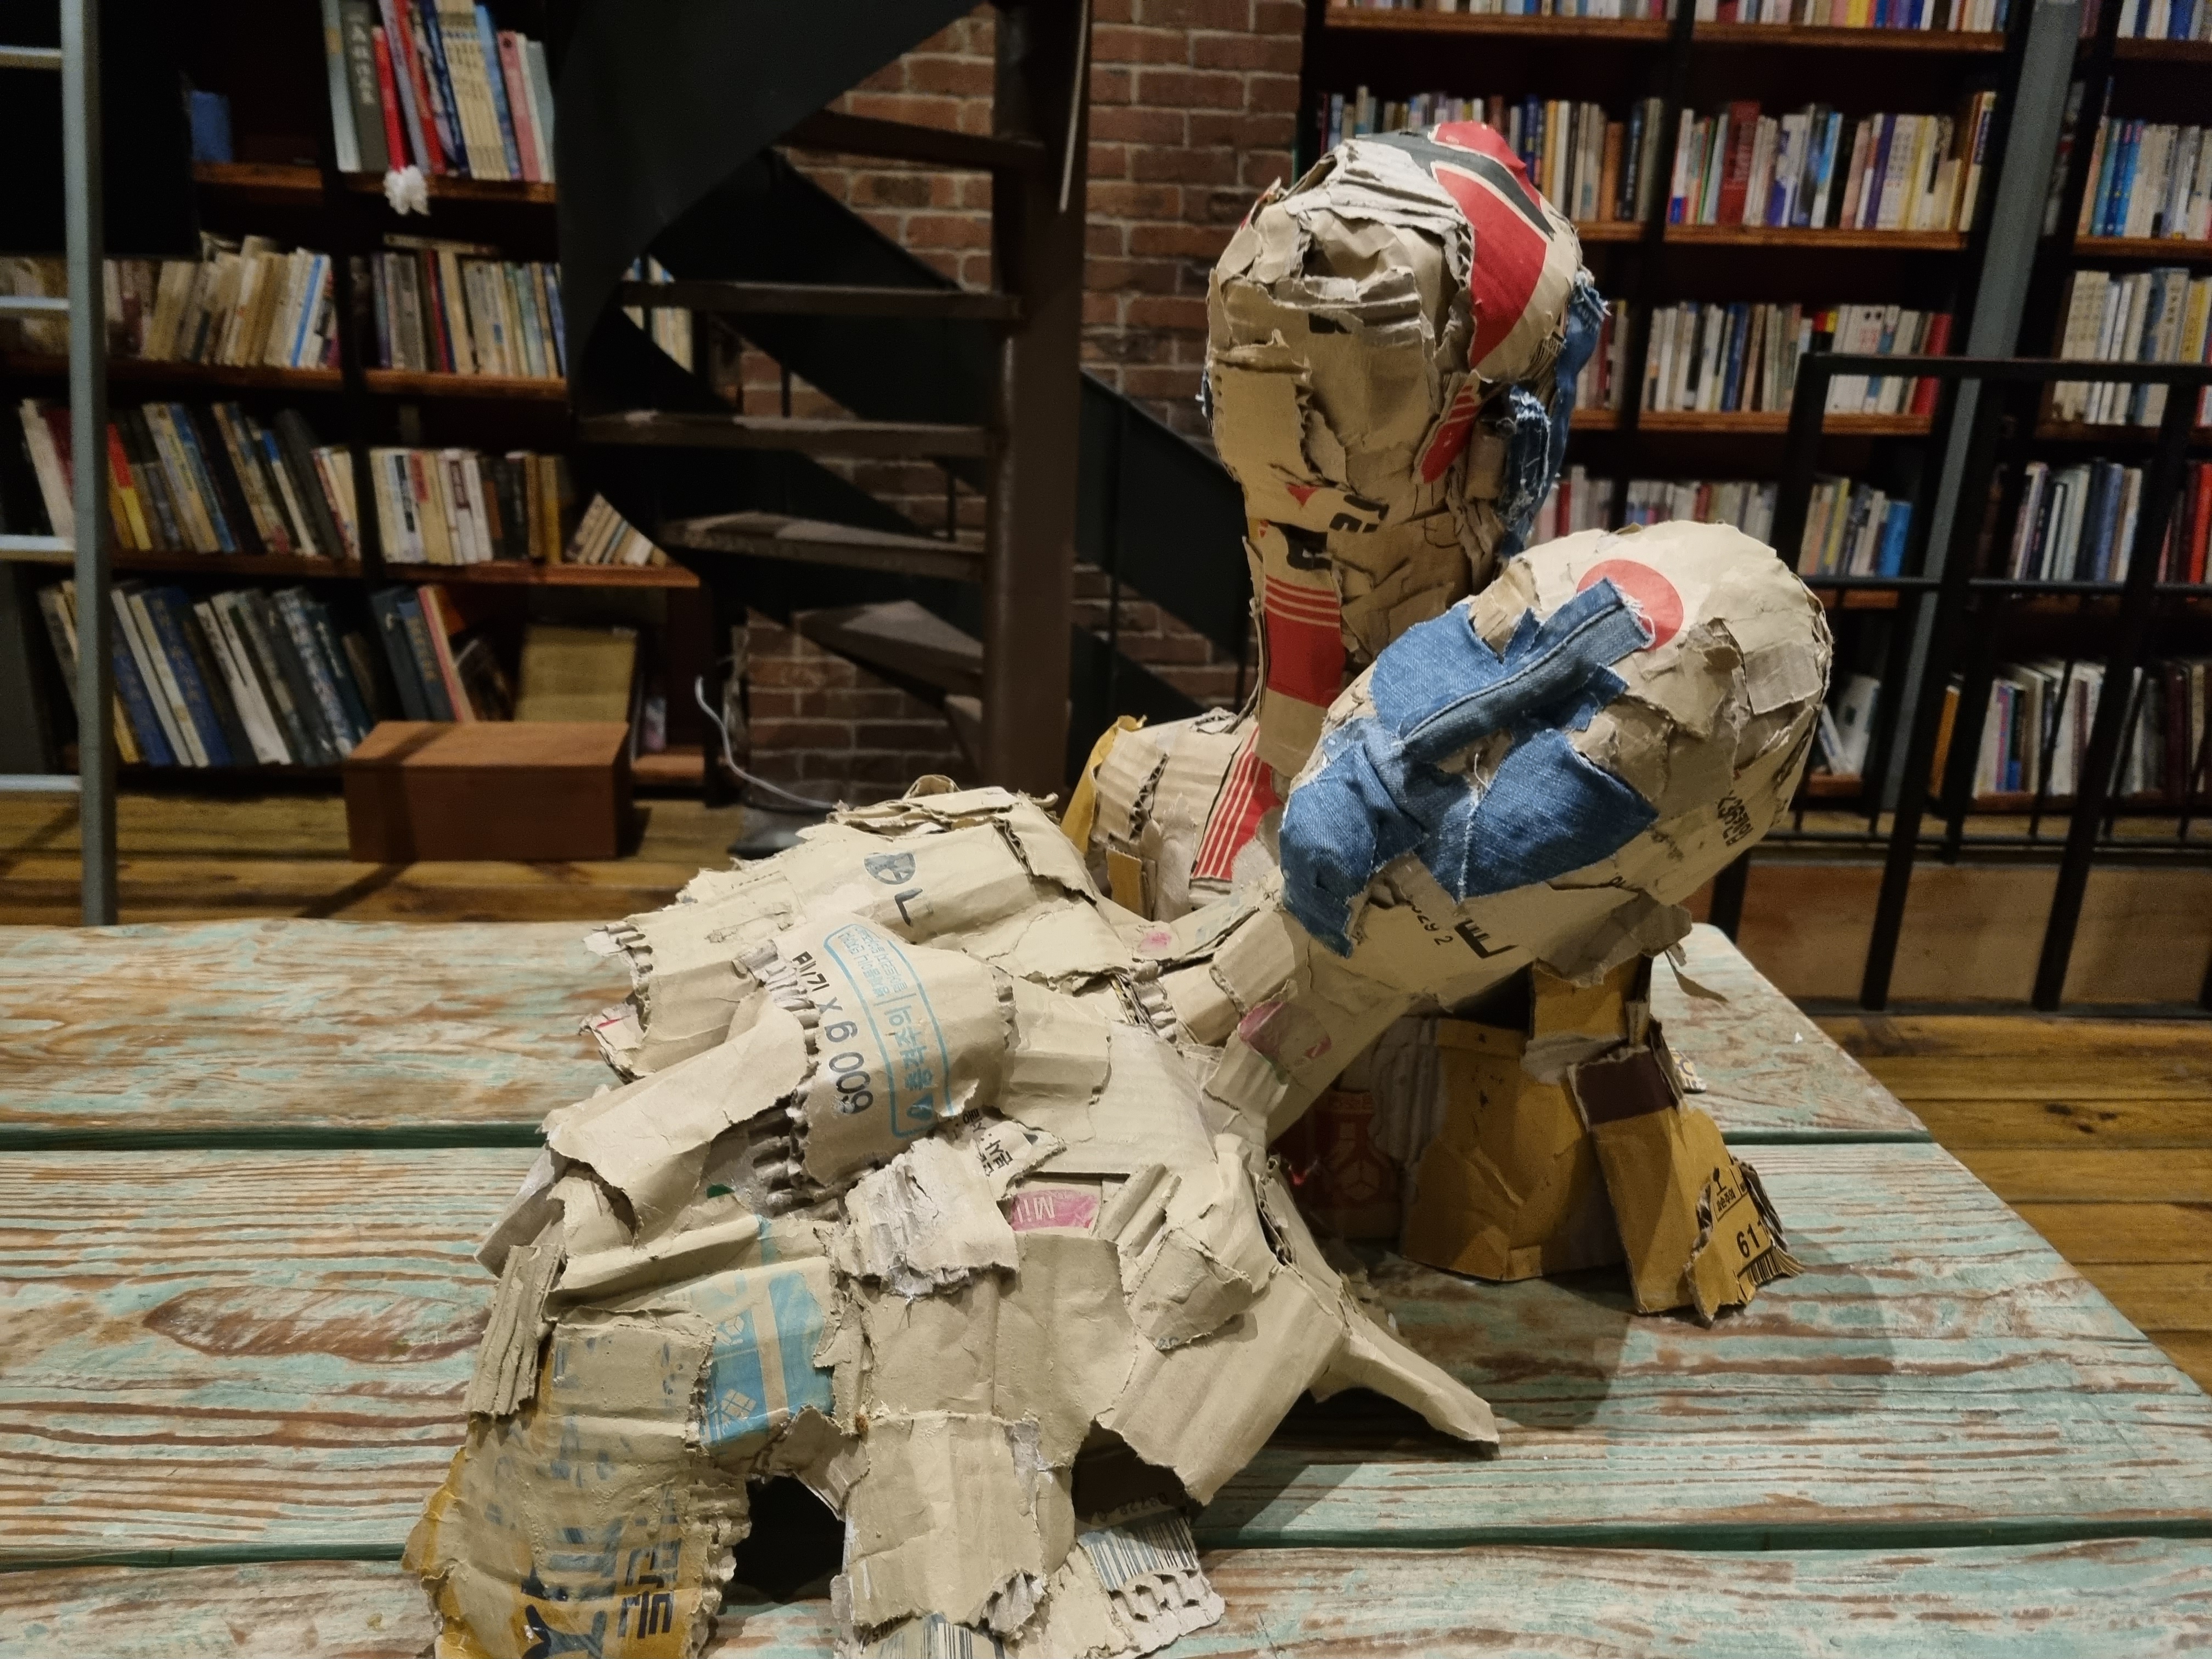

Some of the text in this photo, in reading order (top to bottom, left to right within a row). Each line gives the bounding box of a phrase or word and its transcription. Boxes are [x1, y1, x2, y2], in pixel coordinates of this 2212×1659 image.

[825, 1021, 858, 1042] g
[884, 1006, 933, 1091] 충격주의
[829, 1052, 873, 1114] 600
[985, 1139, 1013, 1169] 본사
[1737, 1221, 1762, 1258] 61
